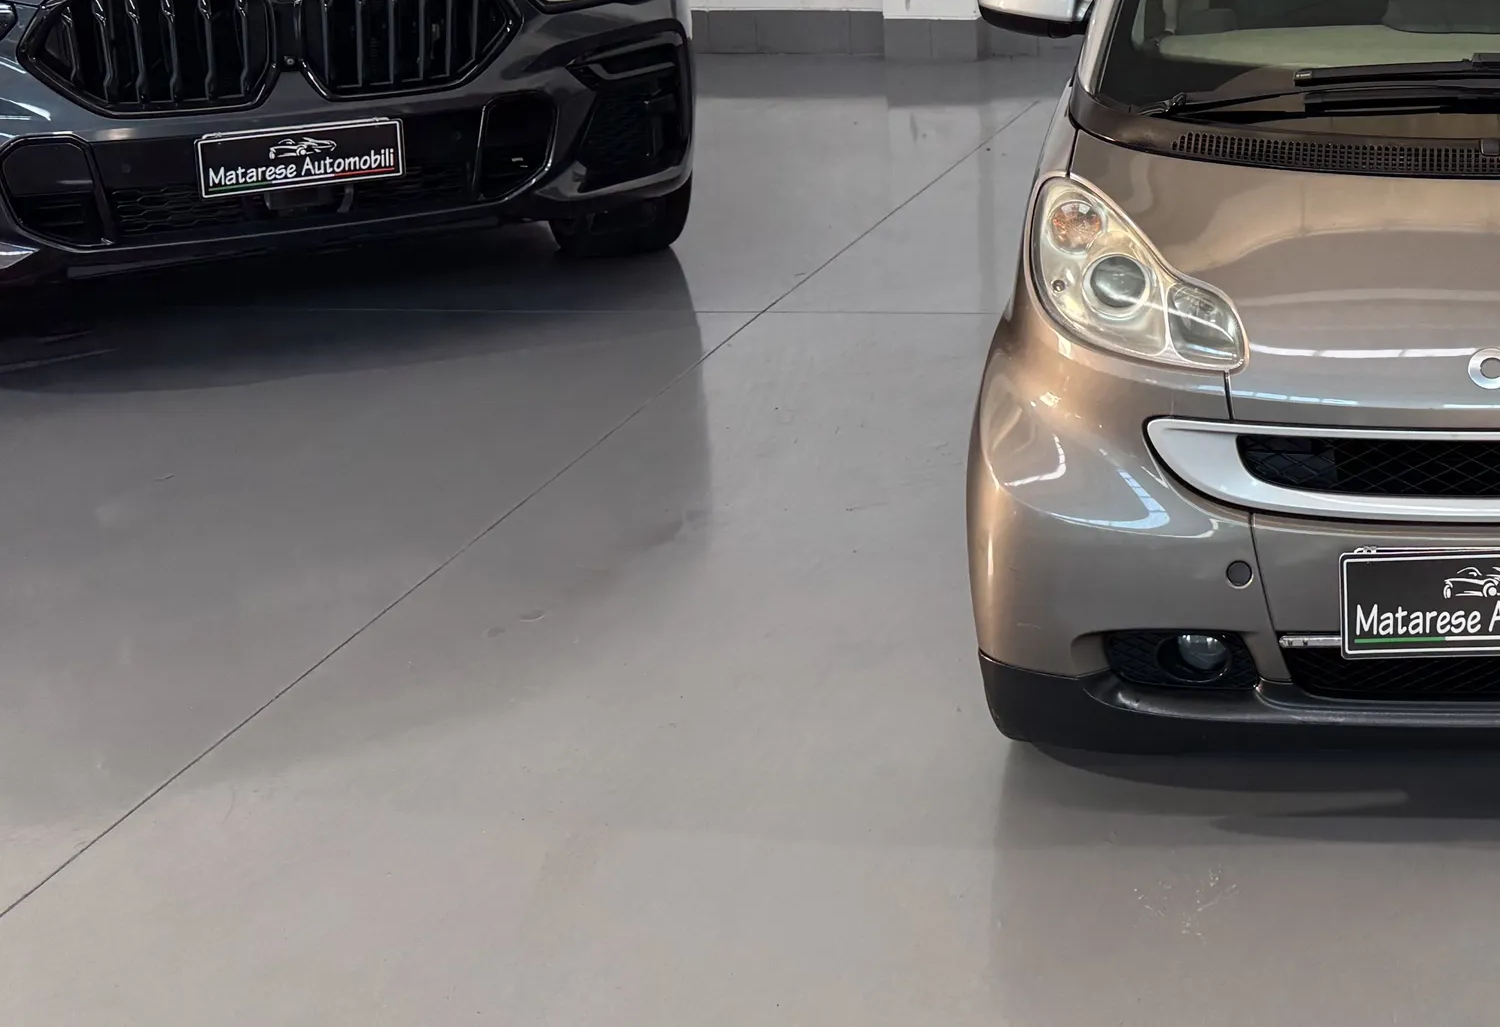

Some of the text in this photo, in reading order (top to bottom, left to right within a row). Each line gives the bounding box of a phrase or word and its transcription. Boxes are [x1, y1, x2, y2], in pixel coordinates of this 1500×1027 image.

[208, 148, 395, 187] Matarese Automobili
[1355, 604, 1482, 636] Matarese
